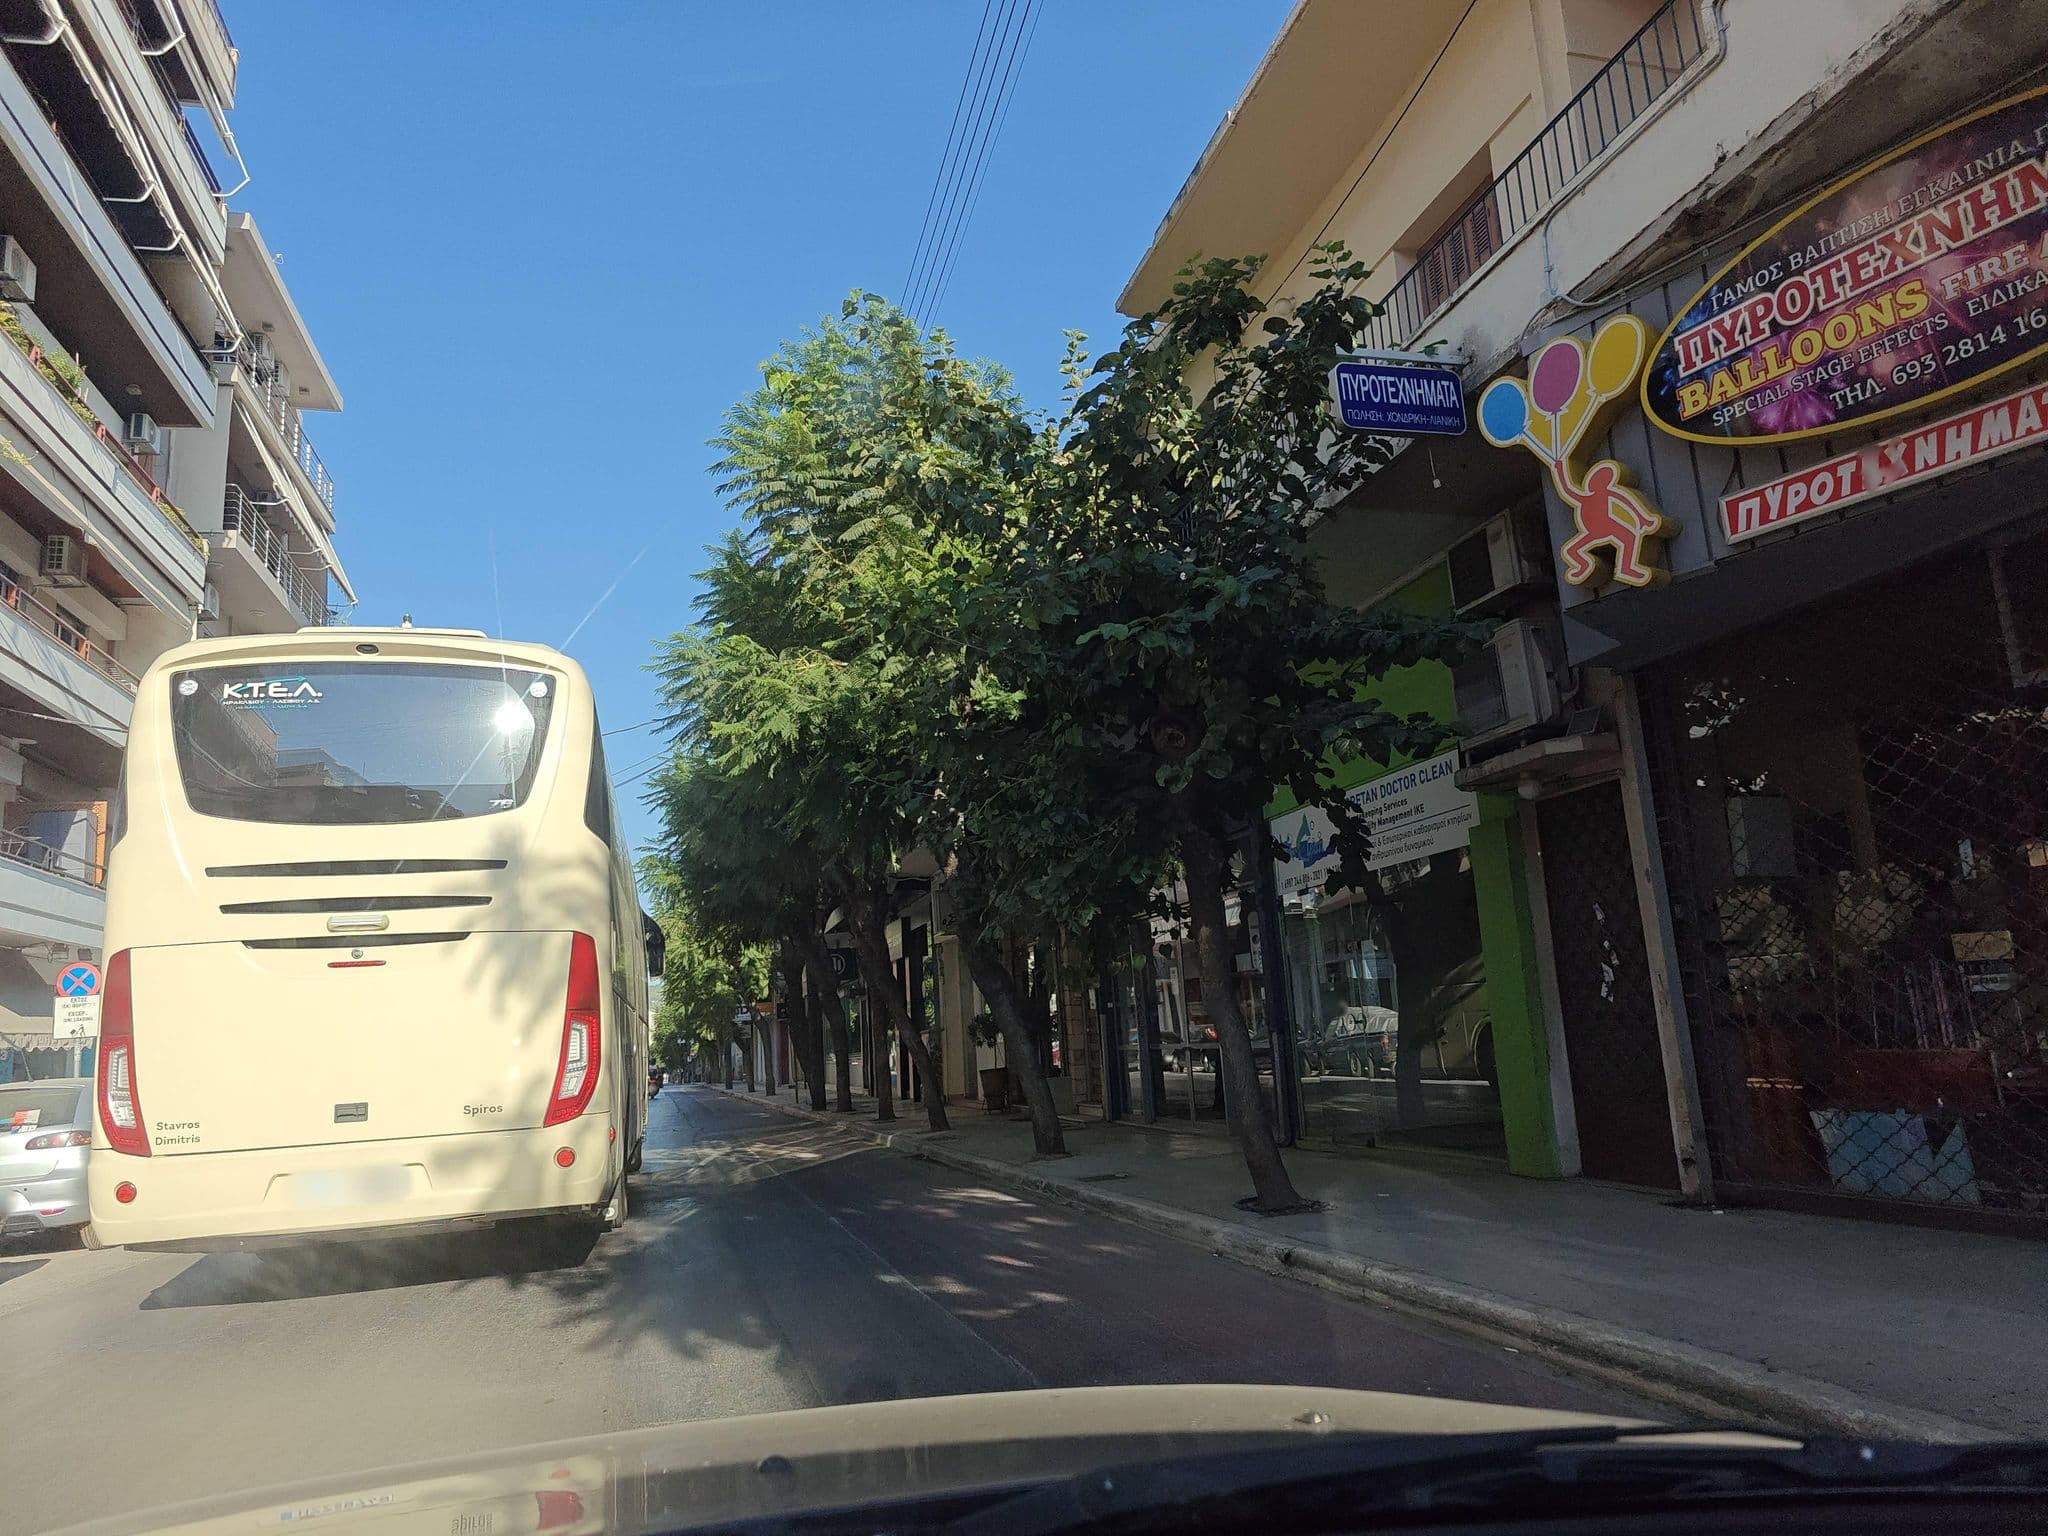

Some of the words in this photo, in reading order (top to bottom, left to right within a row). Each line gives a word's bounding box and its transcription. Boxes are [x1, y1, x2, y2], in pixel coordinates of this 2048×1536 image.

[1711, 262, 1784, 313] ΓΑΜΟΣ
[1788, 206, 1893, 272] ΒΑΠΤΙΣΗ
[1897, 139, 2028, 218] ΕΓΚΑΙΝΙΑ
[1677, 278, 1930, 421] BALLOONS
[1941, 241, 2029, 303] FIRE
[1712, 384, 1789, 426] SPECIAL
[1791, 354, 1855, 393] STAGE
[1857, 313, 1949, 368] EFFECTS
[1966, 270, 2048, 318] ΕΙΔΙΚΑ
[1830, 379, 1886, 411] ΤΗΛ.
[1892, 352, 1937, 386] 693
[1942, 323, 2007, 366] 2814
[1340, 372, 1460, 409] ΠΥΡΟΤΕΧΝΗΜΑΤΑ
[1737, 394, 2048, 533] ΠΥΡΟΤΧΝΗΜΑ
[1346, 787, 1378, 806] RETAN
[1380, 773, 1417, 800] DOCTOR
[1419, 759, 1454, 785] CLEAN
[1378, 807, 1412, 826] Management
[1384, 798, 1408, 813] Services
[156, 1121, 200, 1131] Stavros
[463, 1104, 503, 1118] Spiros
[155, 1134, 201, 1145] Dimitris
